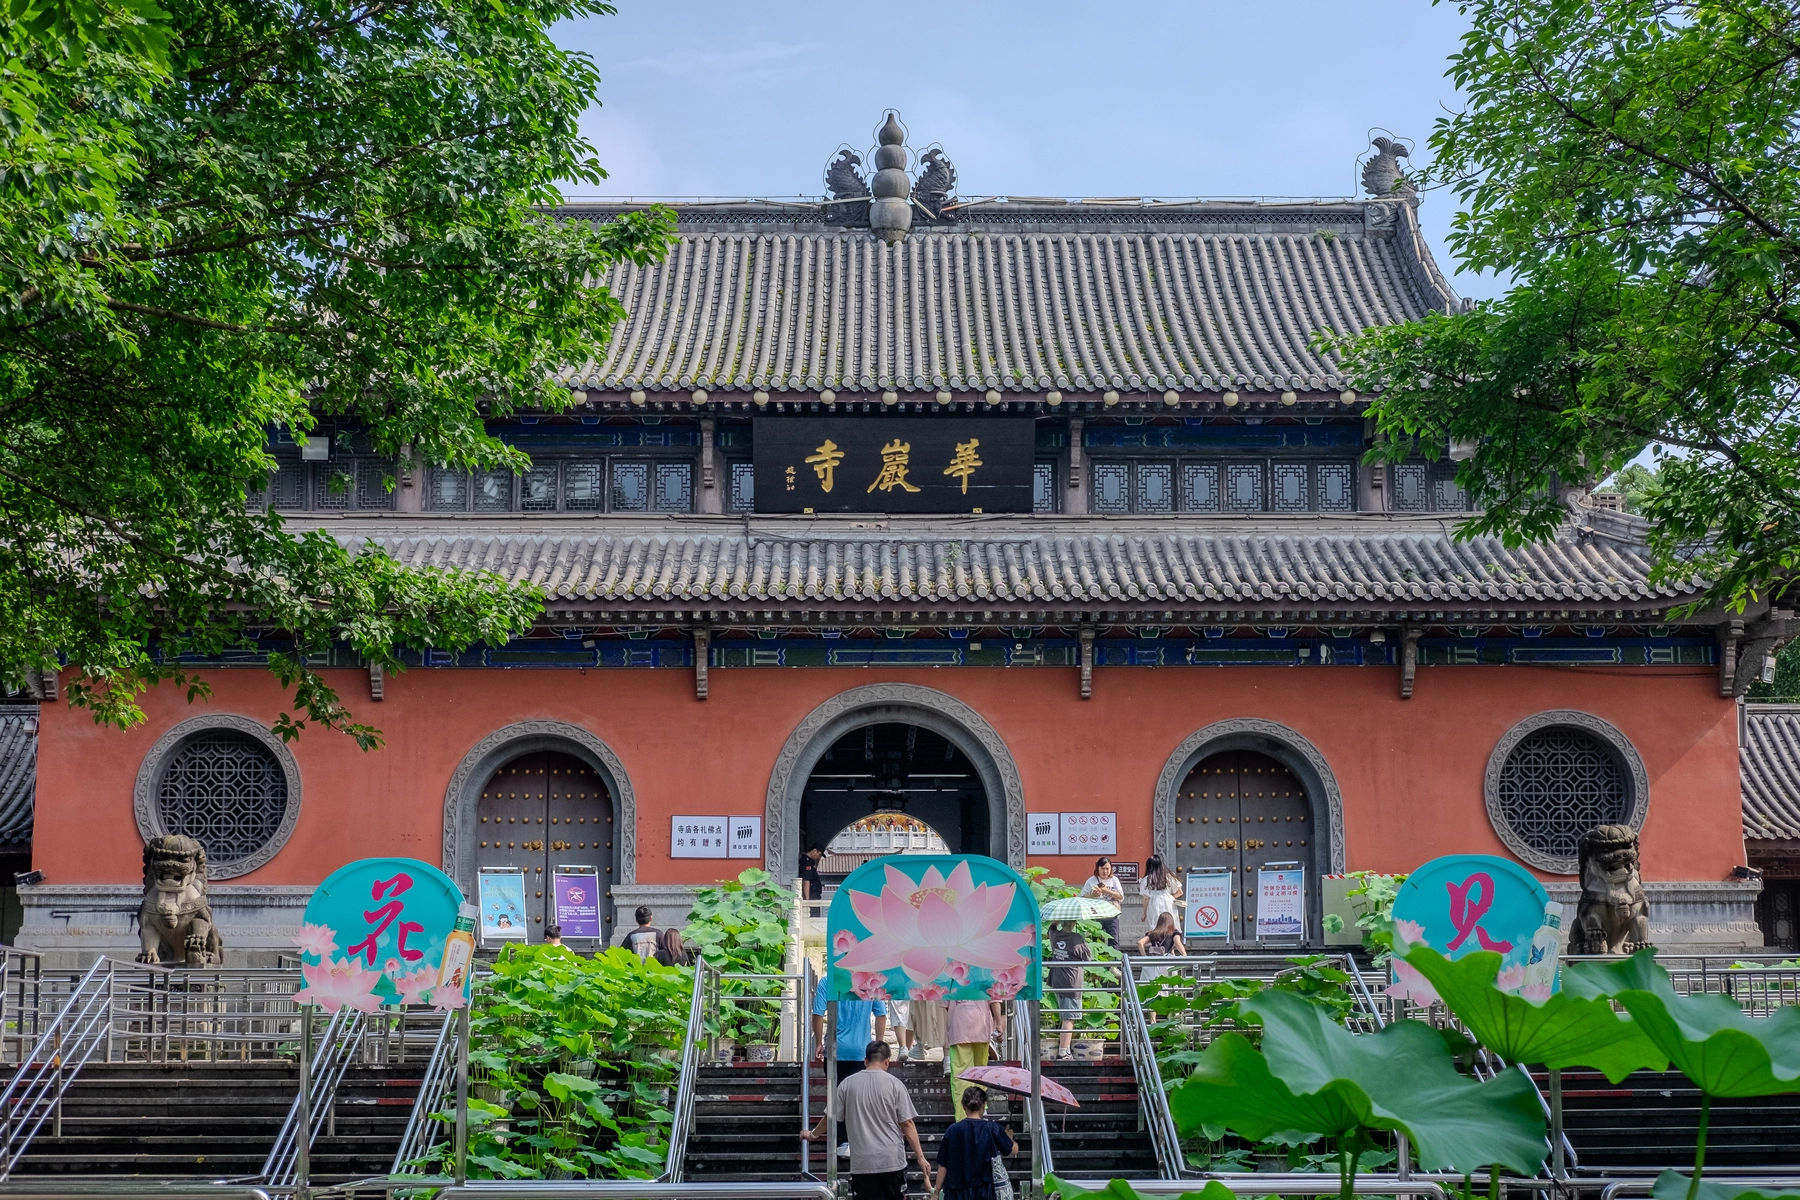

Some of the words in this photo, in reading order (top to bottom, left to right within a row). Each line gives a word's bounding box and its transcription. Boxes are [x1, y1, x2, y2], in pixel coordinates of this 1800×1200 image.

[677, 825, 722, 834] 寺庙各礼佛点
[677, 838, 722, 847] 均有赠香
[347, 872, 425, 967] 花
